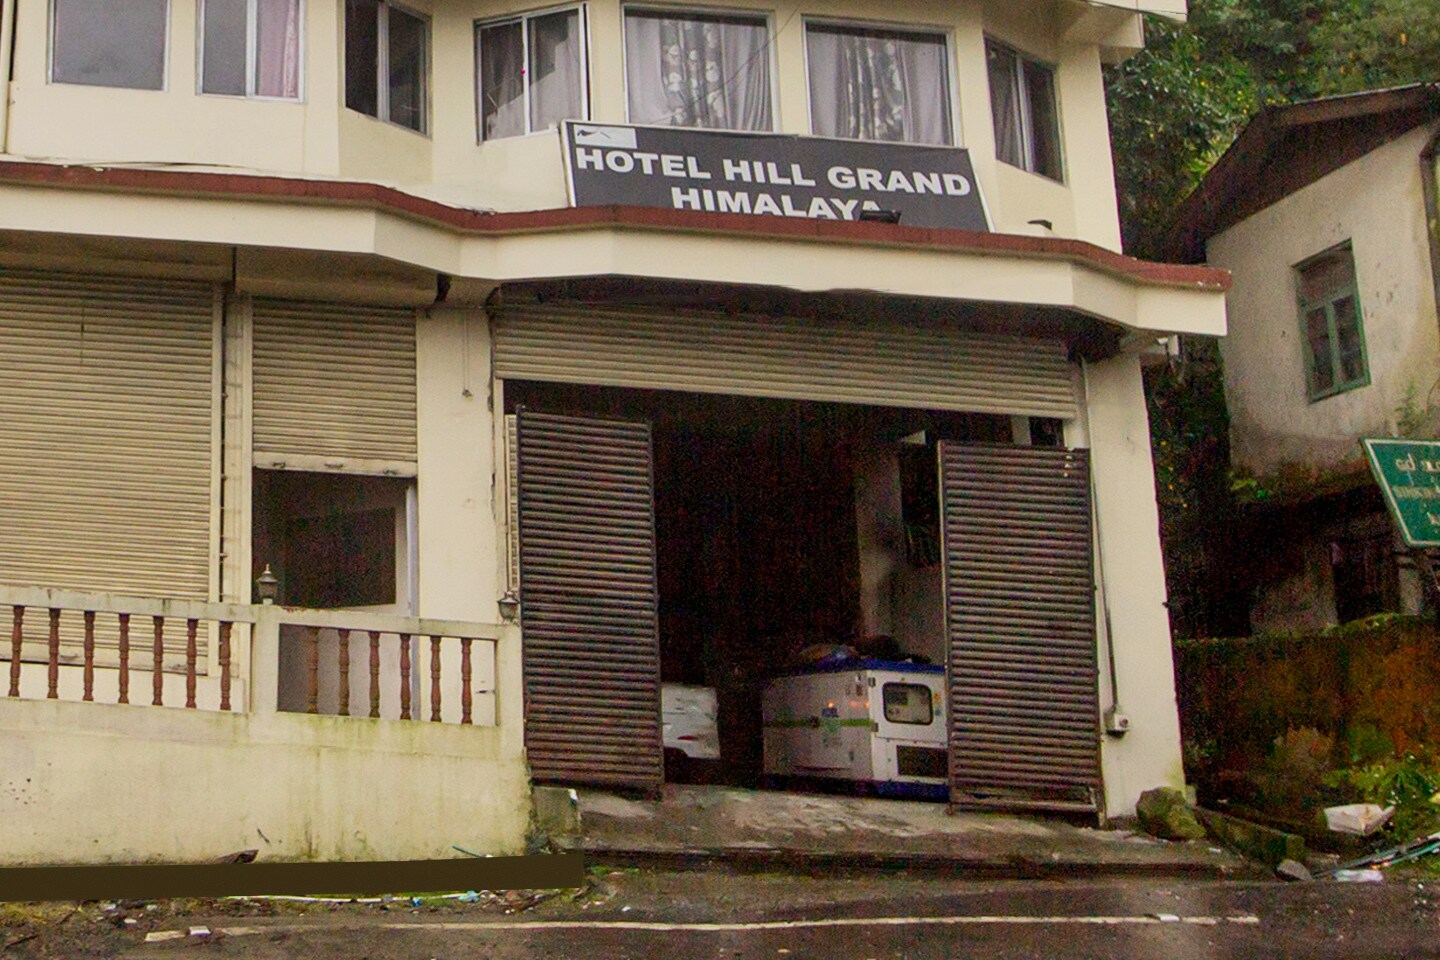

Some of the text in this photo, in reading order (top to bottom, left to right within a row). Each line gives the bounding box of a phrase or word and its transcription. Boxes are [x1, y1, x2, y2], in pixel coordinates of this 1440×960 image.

[575, 147, 971, 196] HOTEL HILL GRAND
